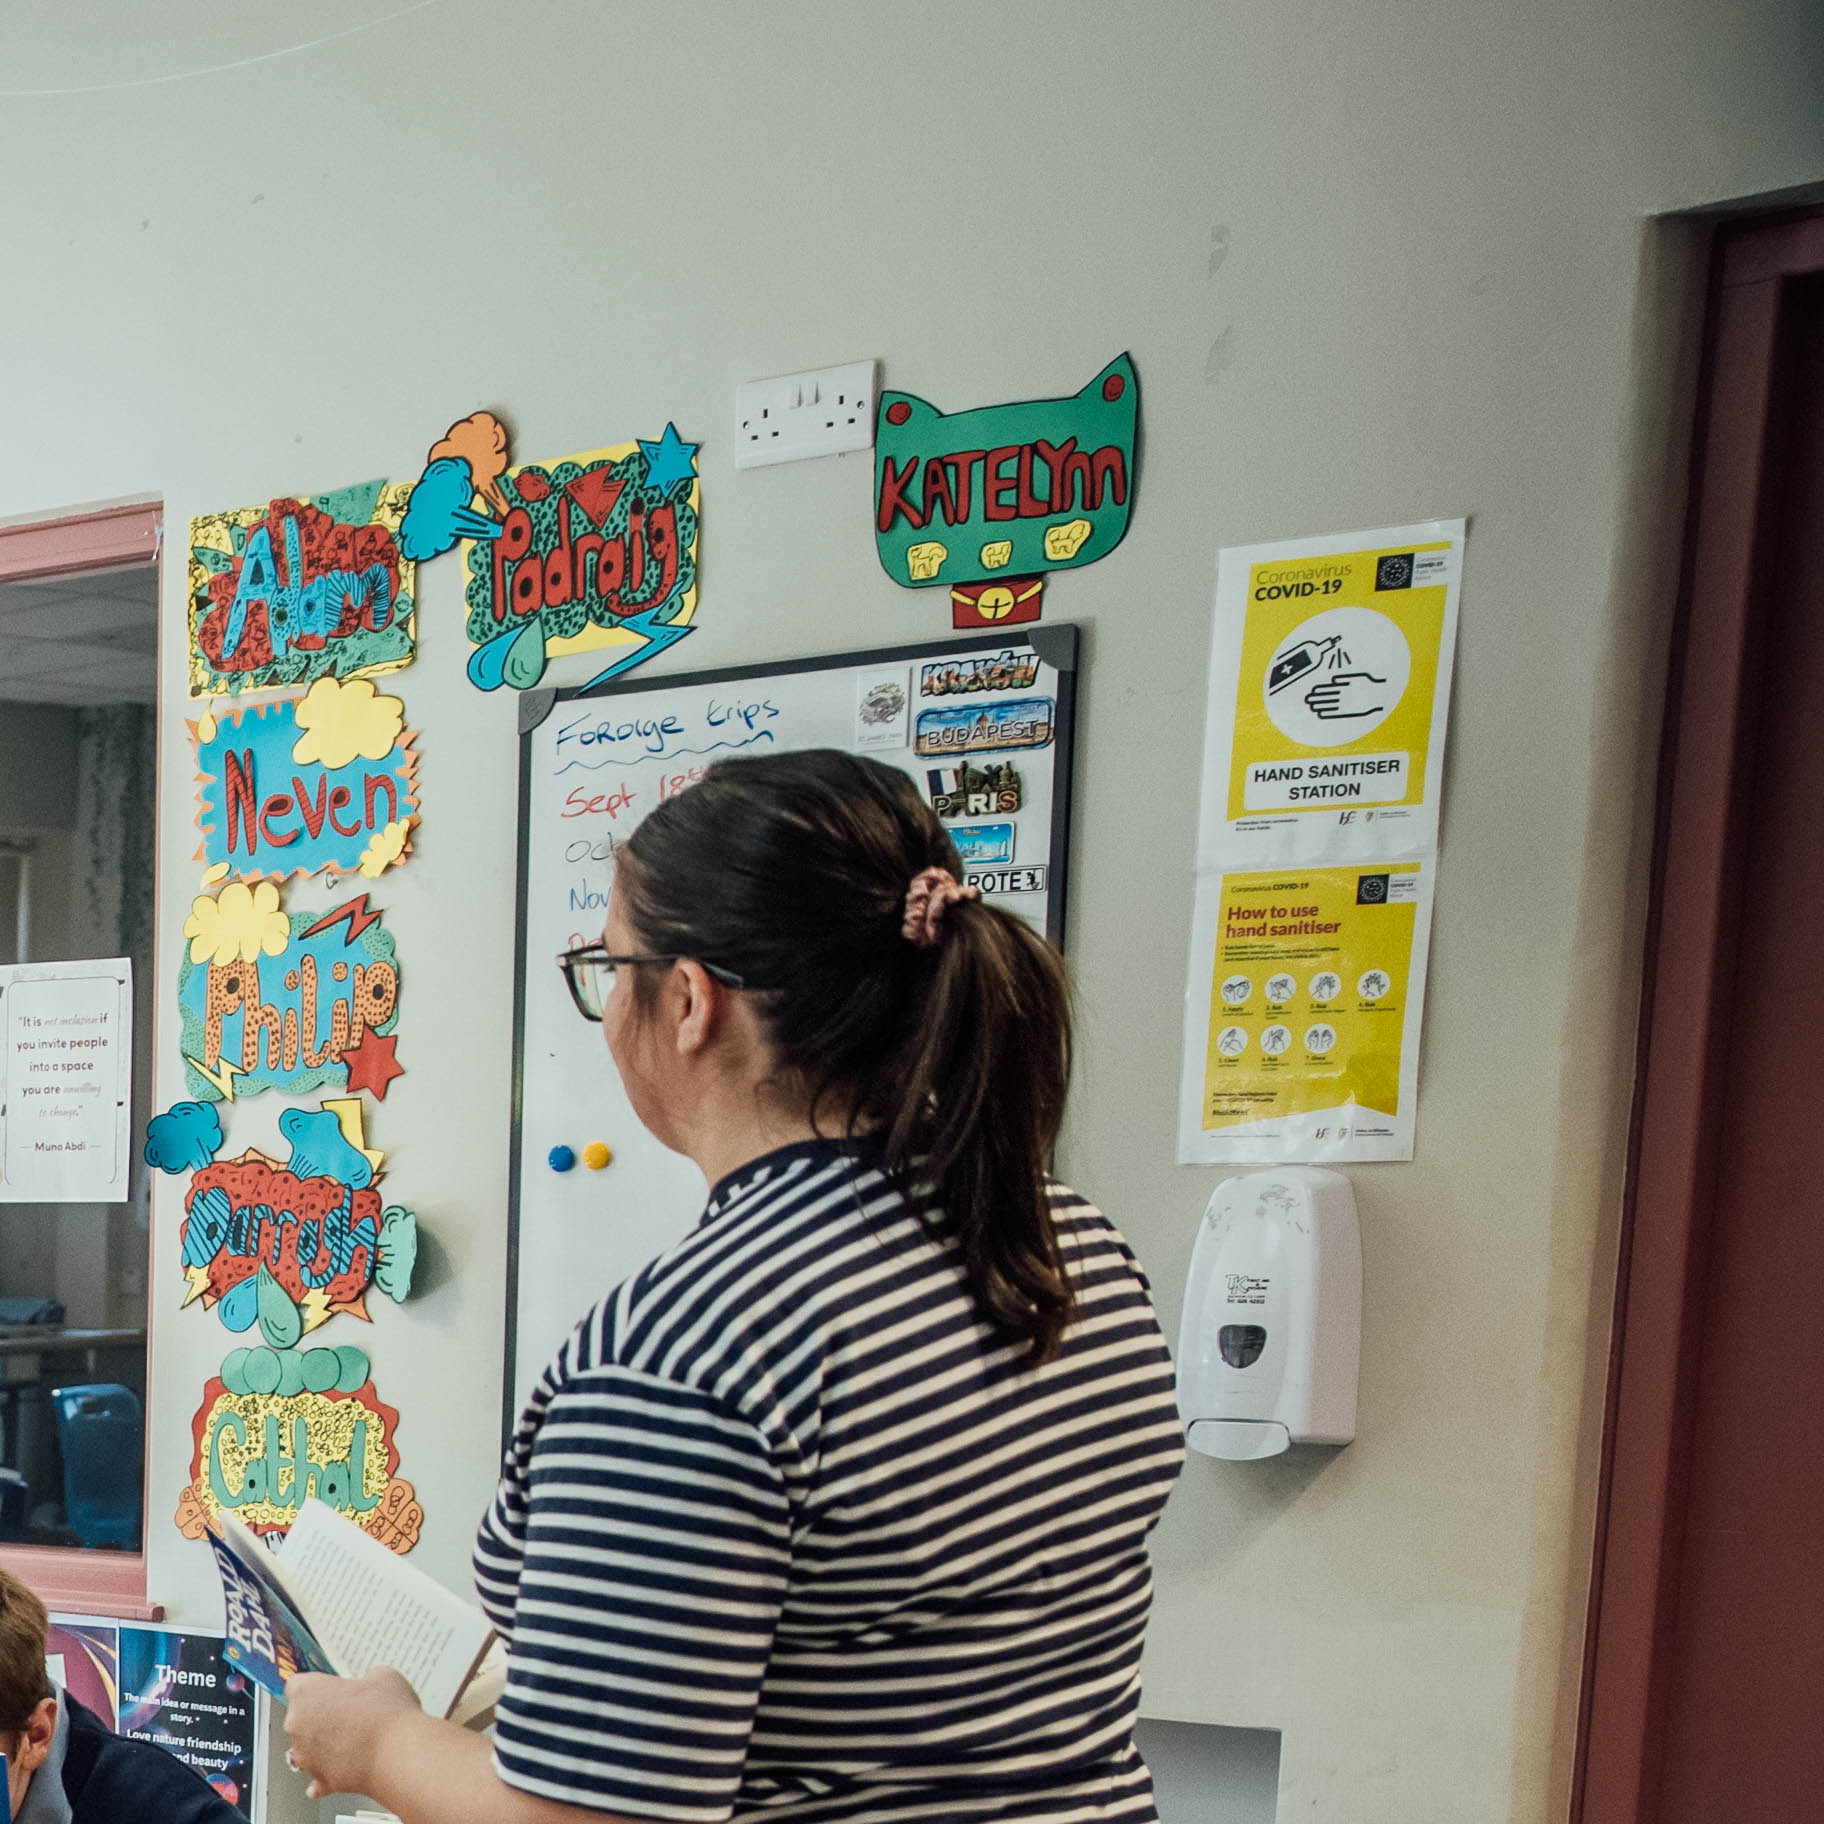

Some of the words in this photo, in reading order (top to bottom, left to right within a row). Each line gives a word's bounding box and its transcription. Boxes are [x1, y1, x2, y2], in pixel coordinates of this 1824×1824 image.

[490, 495, 680, 623] Padraig
[1256, 563, 1352, 585] Coronavirus
[1255, 579, 1342, 601] COVID-19
[706, 699, 781, 730] trips
[927, 719, 1040, 747] BUDAPEST
[1254, 766, 1304, 783] HAND
[1308, 759, 1401, 780] SANITISER
[225, 748, 398, 857] Neven
[560, 782, 637, 820] Sept
[1288, 782, 1362, 801] STATION
[1227, 906, 1267, 920] How
[1270, 905, 1288, 918] to
[1291, 906, 1320, 917] use
[1226, 922, 1268, 938] hand
[1270, 919, 1342, 937] sanitiser
[33, 1016, 42, 1027] is
[99, 1012, 109, 1024] if
[204, 953, 399, 1072] Philip
[16, 1042, 36, 1053] you
[37, 1038, 67, 1049] invite
[69, 1035, 109, 1050] people
[29, 1061, 50, 1072] into
[61, 1062, 94, 1073] space
[22, 1086, 42, 1098] you
[43, 1085, 61, 1095] are
[64, 1140, 87, 1151] Abdi
[209, 1411, 382, 1513] Cathal
[154, 1664, 217, 1688] Theme
[124, 1692, 139, 1703] The
[140, 1695, 160, 1706] main
[161, 1697, 179, 1707] idea
[180, 1701, 189, 1709] or
[190, 1702, 228, 1716] message
[229, 1705, 238, 1715] in
[239, 1708, 246, 1716] a
[170, 1713, 194, 1725] story.
[126, 1728, 152, 1741] Love
[152, 1733, 186, 1747] nature
[186, 1737, 243, 1757] friendship
[174, 1753, 190, 1764] nd
[191, 1752, 229, 1772] beauty
